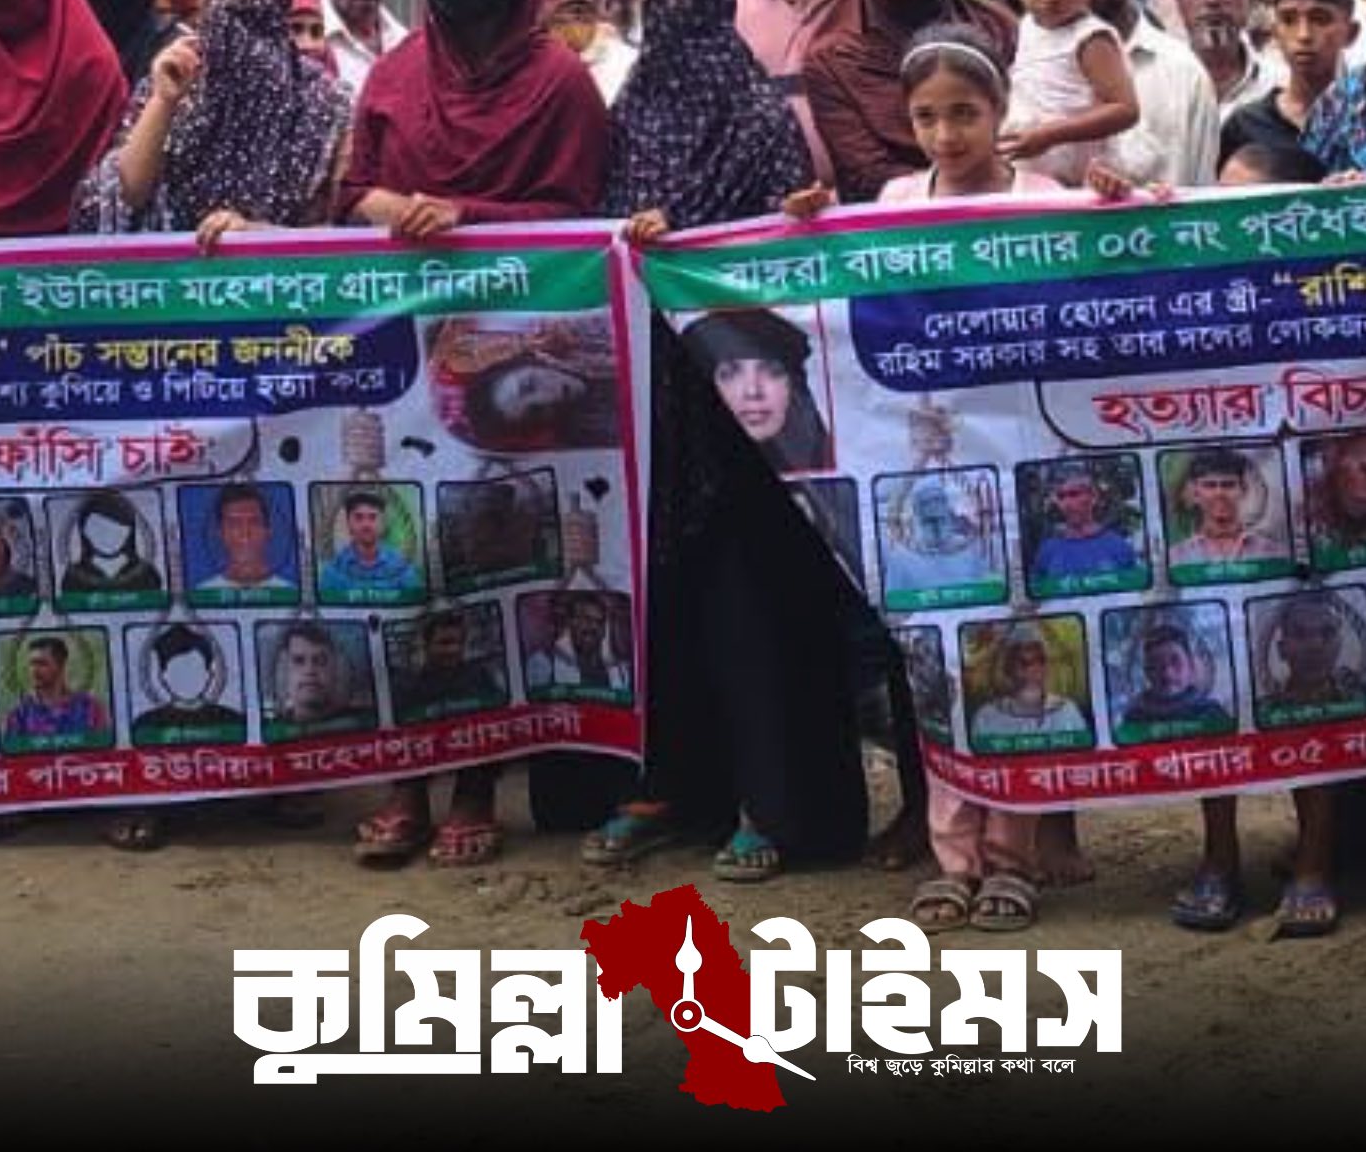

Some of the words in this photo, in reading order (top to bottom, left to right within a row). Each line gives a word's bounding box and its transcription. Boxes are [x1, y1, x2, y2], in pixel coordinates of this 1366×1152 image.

[840, 242, 957, 282] বাজার
[972, 229, 1082, 268] থানার
[1097, 225, 1157, 259] ০৫
[1171, 218, 1229, 252] নং
[17, 271, 170, 313] ইউনিয়ন
[181, 270, 326, 311] মহেশপুর
[337, 267, 406, 304] গ্রাম
[419, 257, 530, 300] নিবাসী
[1058, 294, 1157, 329] হোসেন
[1168, 291, 1214, 319] এর
[27, 334, 84, 374] পাঁচ
[231, 324, 355, 367] জননীকে
[873, 342, 941, 379] রহিম
[953, 339, 1046, 371] সরকার
[1058, 335, 1101, 362] সহ
[1113, 328, 1165, 357] তার
[1176, 320, 1253, 353] দলের
[38, 375, 121, 410] কুপিয়ে
[134, 381, 153, 403] ও
[163, 372, 248, 403] পিটিয়ে
[253, 374, 316, 405] হত্যা
[1093, 381, 1263, 432] হত্যার
[117, 426, 209, 476] চাই
[27, 753, 128, 792] পশ্চিম
[140, 749, 274, 788] ইউনিয়ন
[286, 732, 436, 771] মহেশপুর
[448, 705, 582, 749] গ্রামবাসী
[1024, 760, 1141, 794] বাজার
[1153, 746, 1257, 780] থানার
[1270, 741, 1323, 767] ০৫
